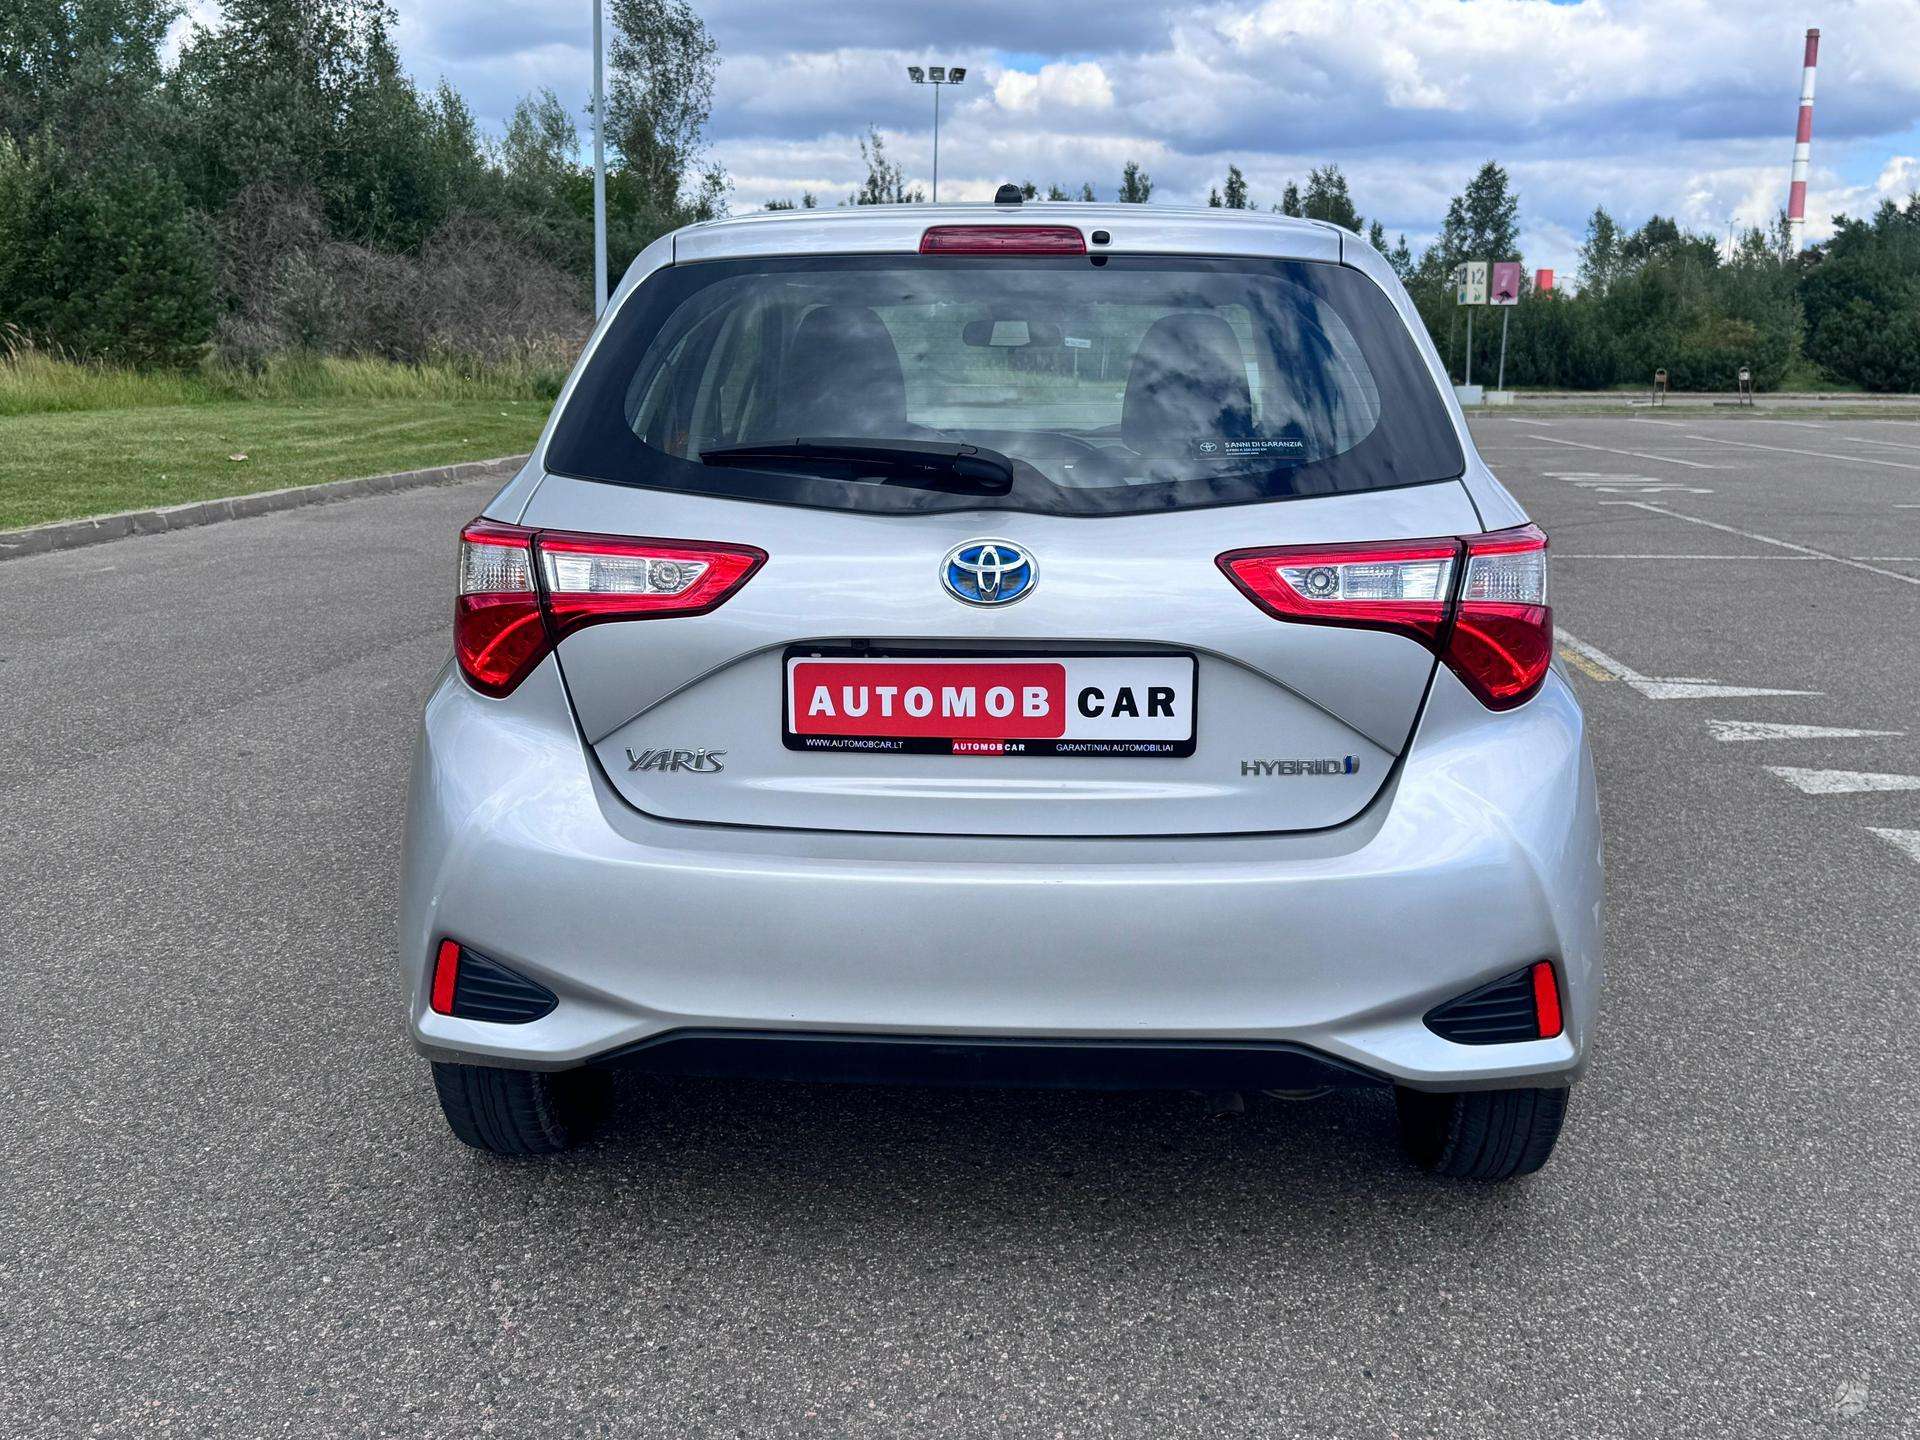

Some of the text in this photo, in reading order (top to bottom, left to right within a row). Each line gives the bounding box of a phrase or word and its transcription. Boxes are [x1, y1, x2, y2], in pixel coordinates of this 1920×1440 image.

[1472, 268, 1484, 285] 12
[1501, 269, 1513, 287] 7
[808, 686, 1176, 718] AUTOMOB CAR
[805, 738, 904, 749] WWW.AUTOMOBCAR.LT
[952, 743, 1025, 751] AUTOMOBCAR
[1056, 743, 1174, 752] GARANTINIAI AUTOMOBILIAI
[1241, 759, 1341, 776] HYBRID
